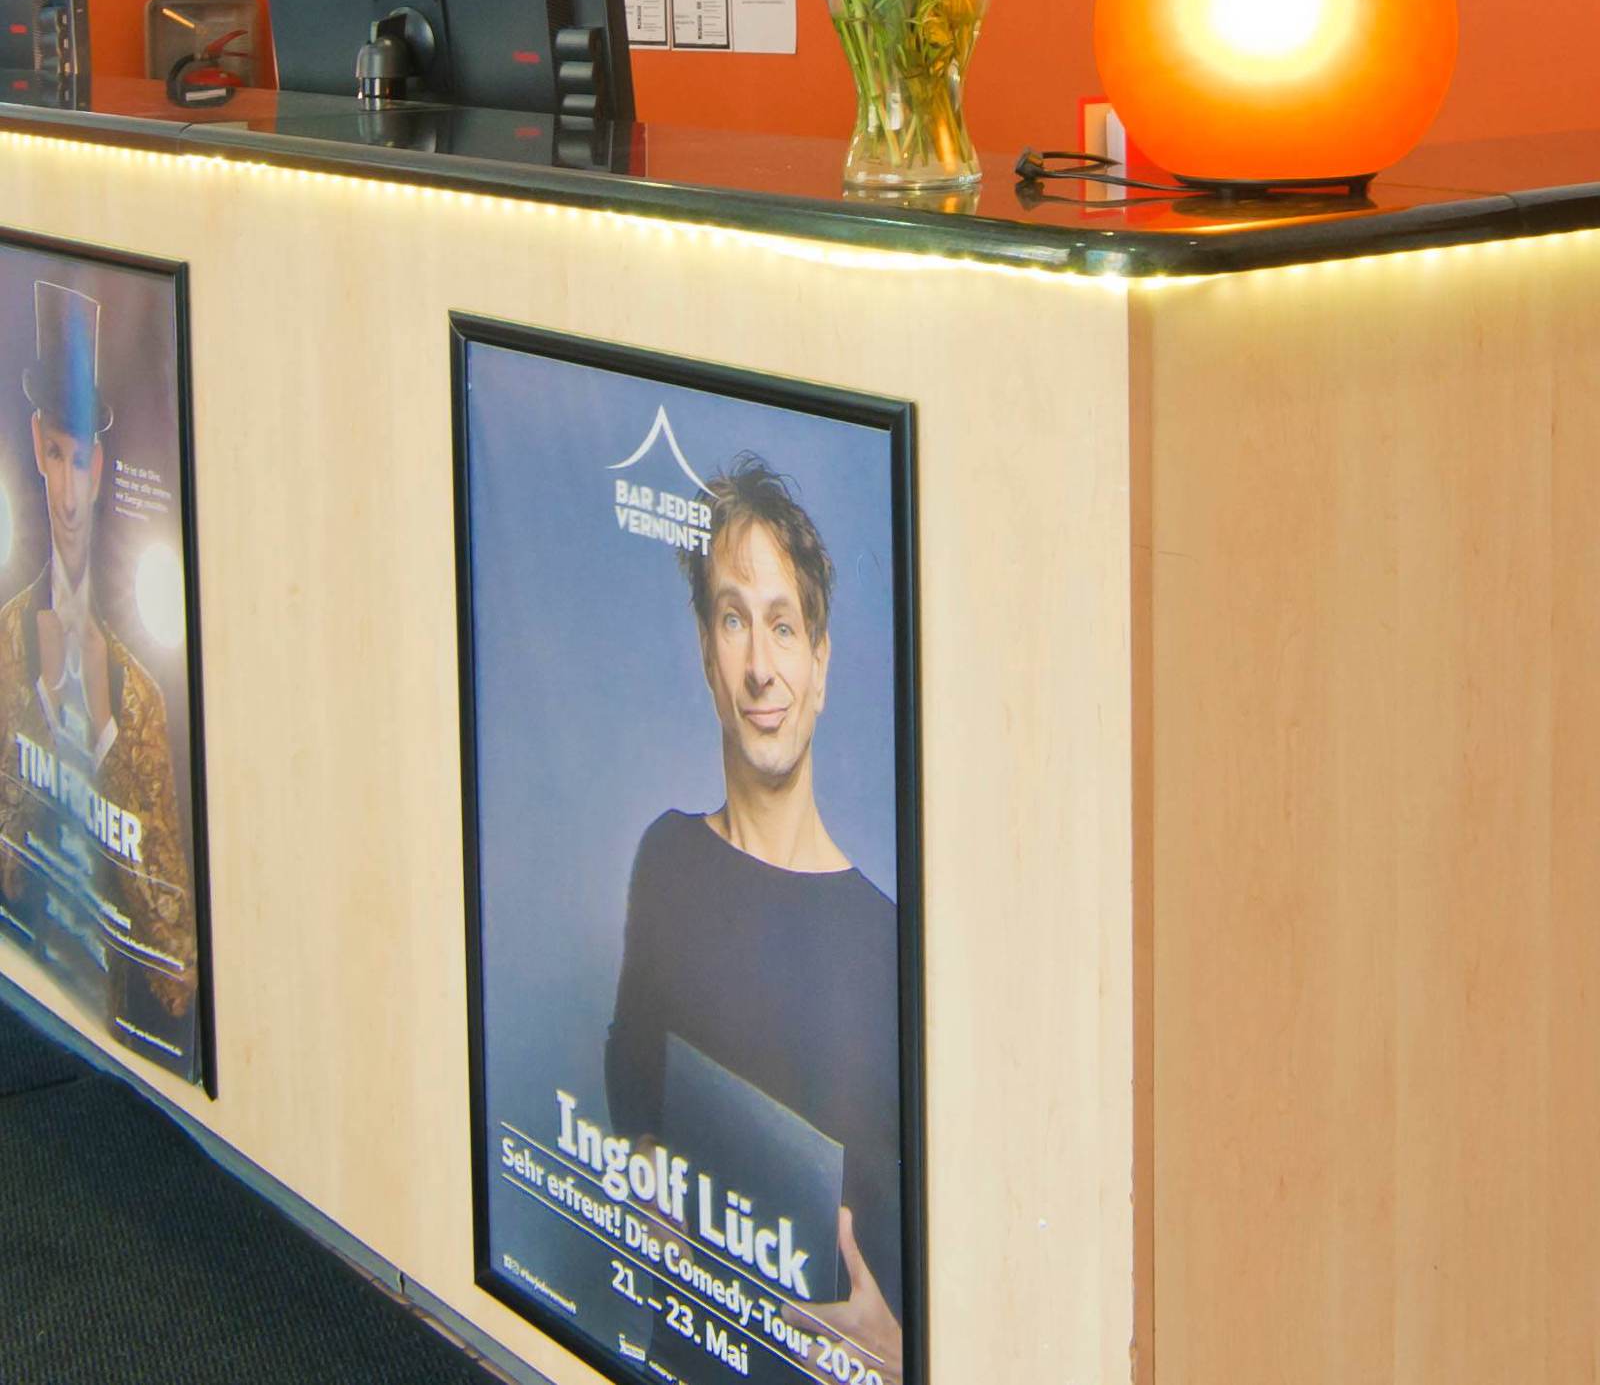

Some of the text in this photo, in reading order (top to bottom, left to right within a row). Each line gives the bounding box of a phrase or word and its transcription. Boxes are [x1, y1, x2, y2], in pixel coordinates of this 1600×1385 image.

[615, 478, 713, 530] BAR JEDER
[615, 504, 712, 557] VERNUNFT
[15, 731, 59, 799] TIM
[556, 1088, 690, 1223] Ingolf
[698, 1172, 811, 1301] Lück
[502, 1136, 545, 1187] Sehr
[547, 1172, 621, 1239] erfreut!
[625, 1213, 661, 1263] Die
[663, 1240, 813, 1360] Comedy-Tour
[611, 1259, 643, 1306] 21.
[665, 1295, 702, 1345] 23.
[705, 1319, 749, 1377] Mai
